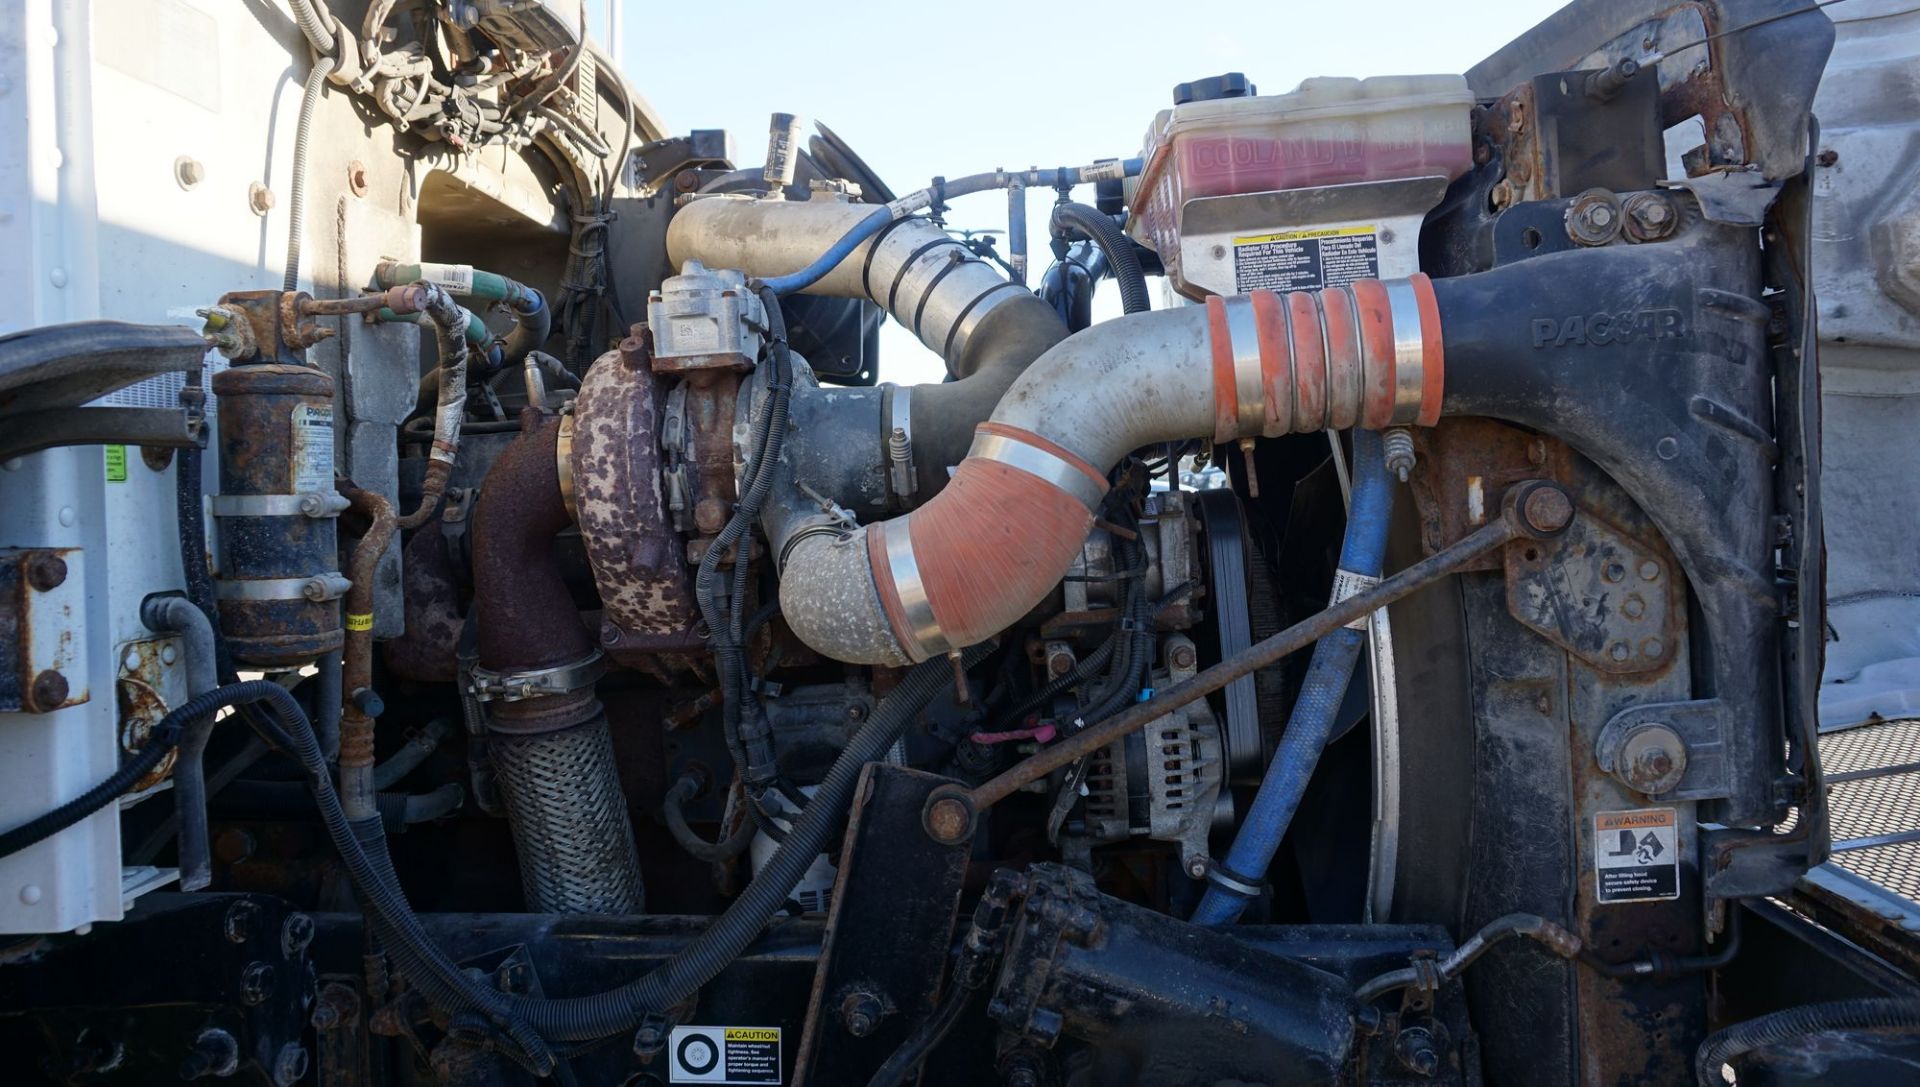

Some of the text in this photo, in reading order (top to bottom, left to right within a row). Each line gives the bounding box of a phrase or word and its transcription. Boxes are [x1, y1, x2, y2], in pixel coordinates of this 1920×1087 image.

[1532, 307, 1685, 348] PACCAR
[1615, 815, 1665, 826] WARNING
[735, 1031, 778, 1039] CAUTION
